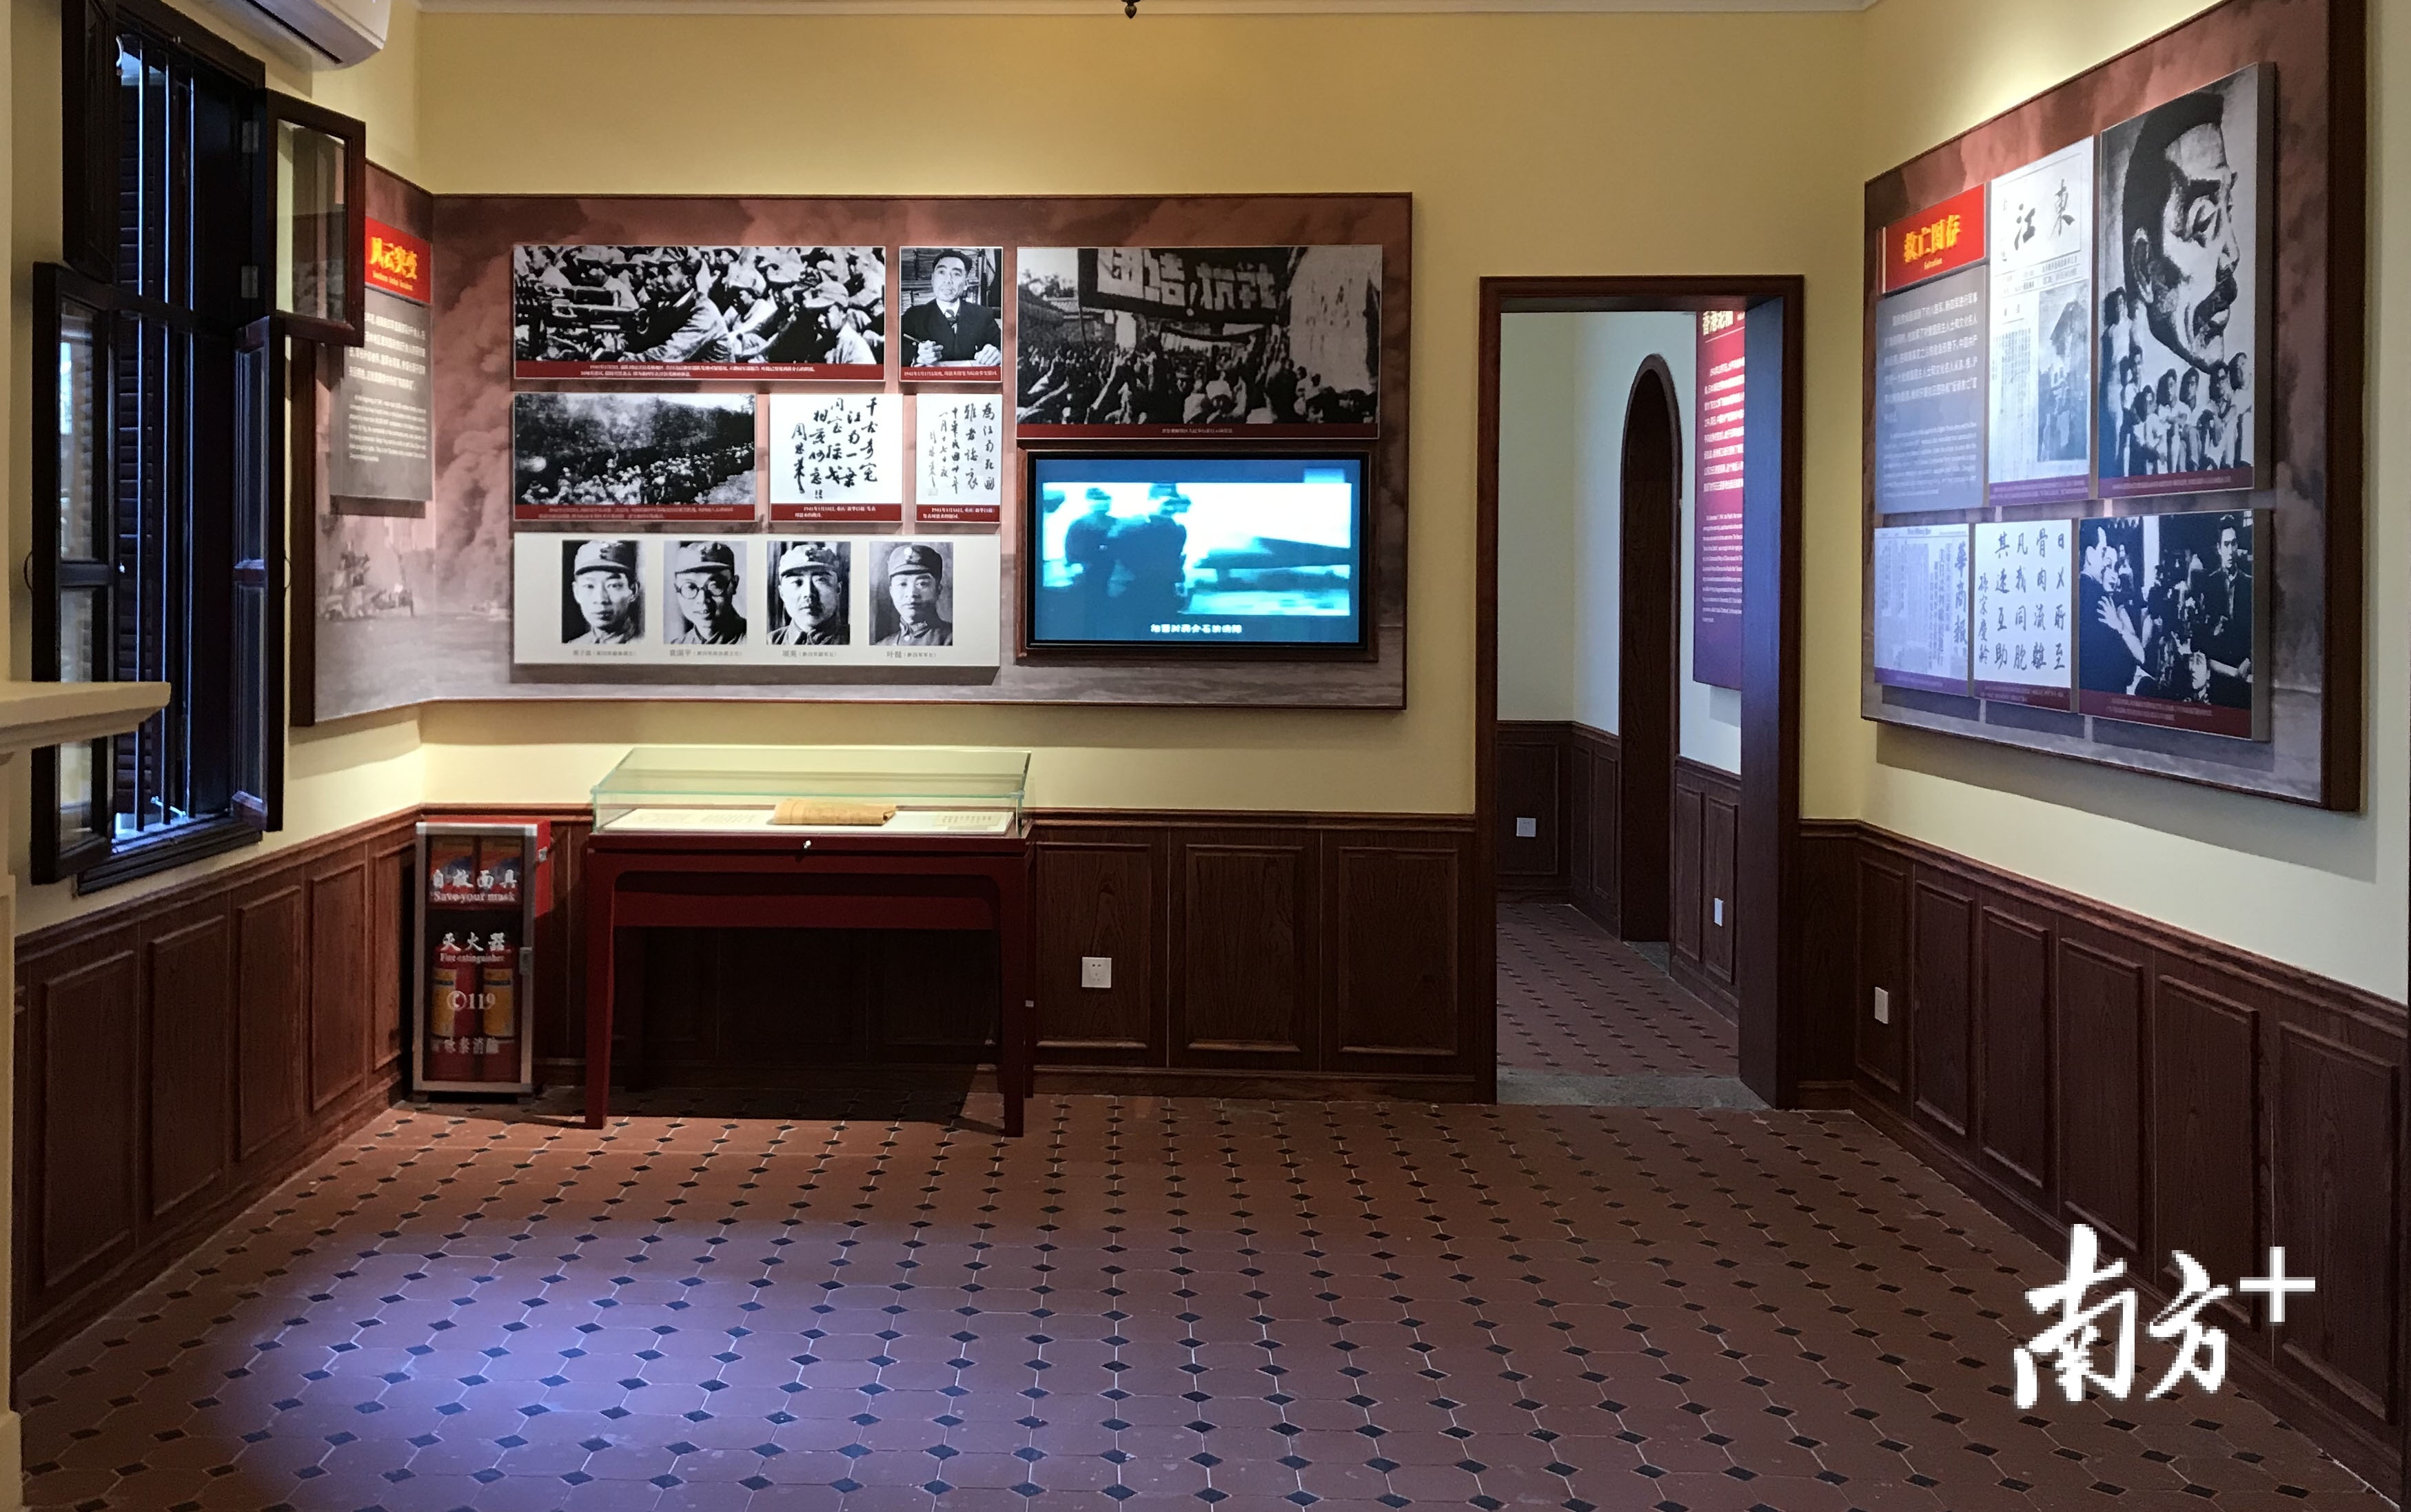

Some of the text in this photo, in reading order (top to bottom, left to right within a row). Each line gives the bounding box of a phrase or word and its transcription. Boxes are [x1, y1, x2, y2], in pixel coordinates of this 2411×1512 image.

[1903, 214, 1962, 263] 救亡图存
[370, 237, 417, 280] 风云突变
[433, 869, 518, 889] 自救面具
[434, 891, 515, 903] Save your mask
[440, 932, 505, 952] 灭火器
[468, 993, 496, 1010] 119
